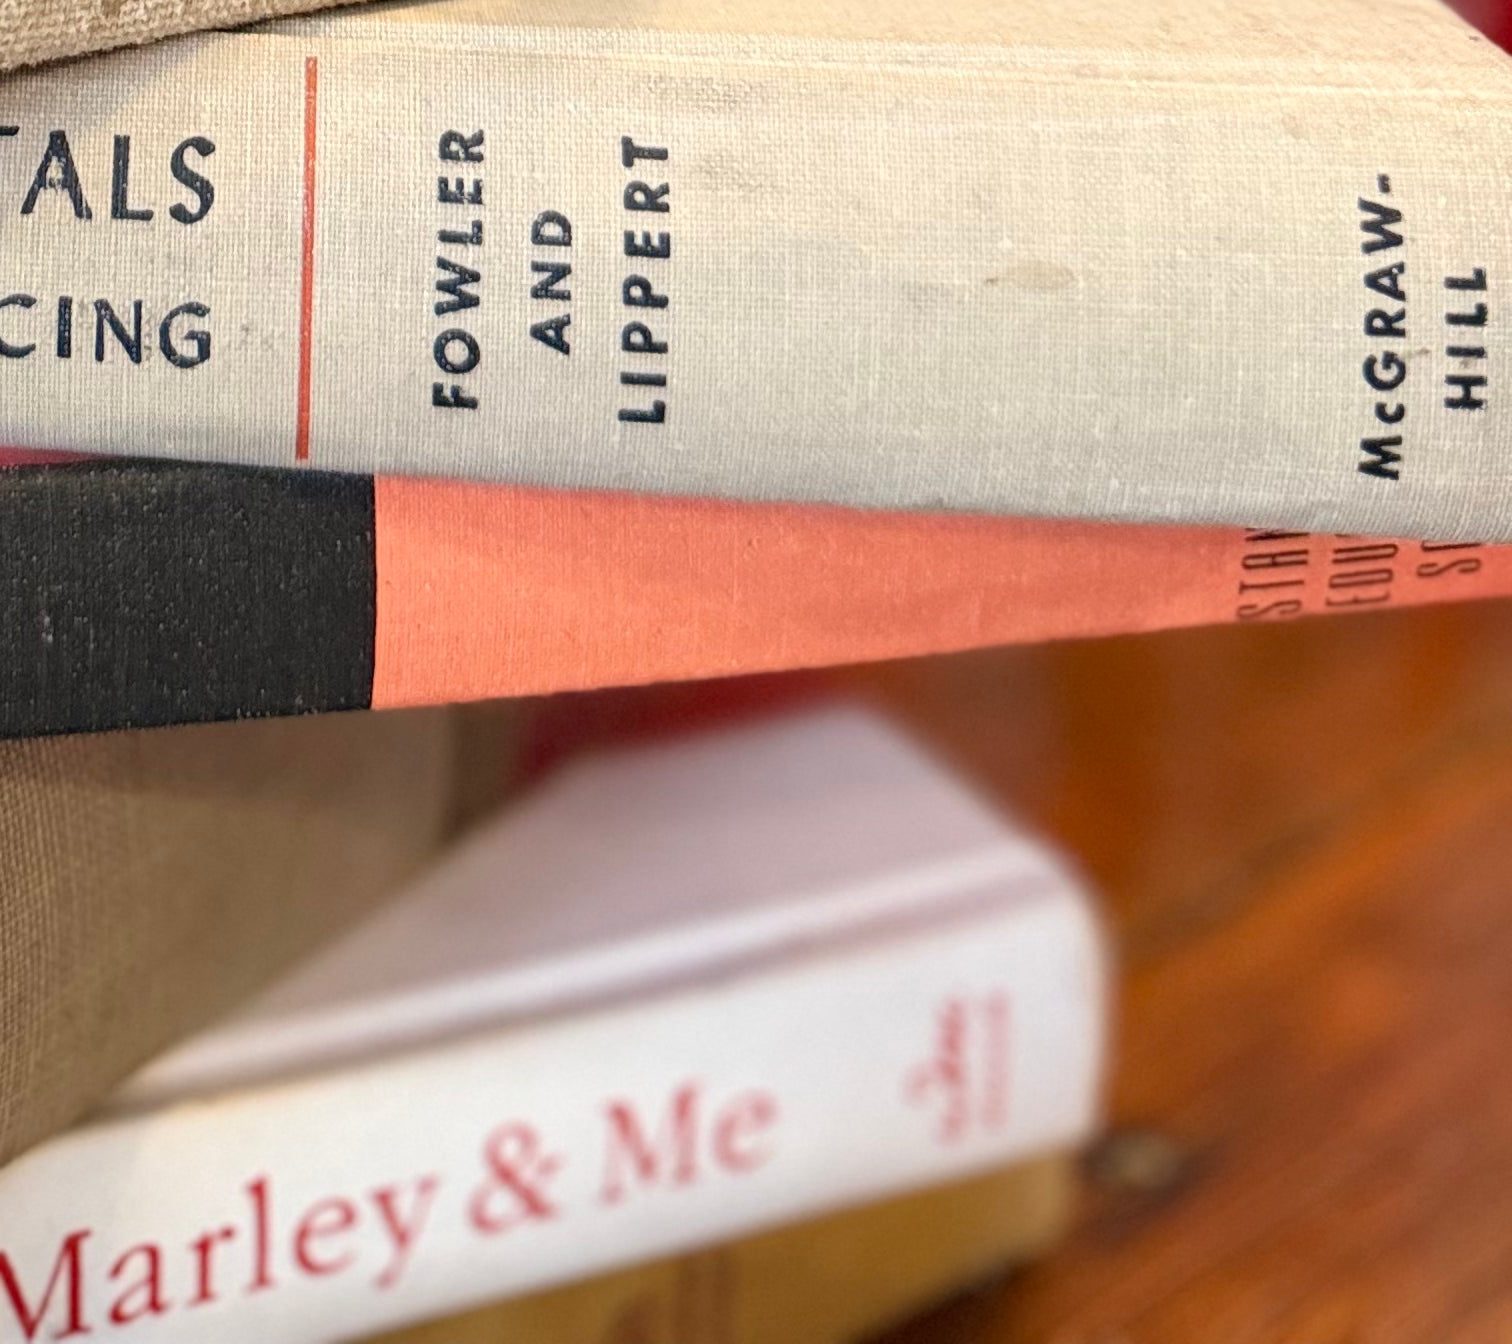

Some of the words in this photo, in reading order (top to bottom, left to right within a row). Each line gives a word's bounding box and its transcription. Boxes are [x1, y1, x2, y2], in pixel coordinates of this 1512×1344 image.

[431, 127, 485, 410] FOWLER
[529, 209, 573, 356] AND
[617, 134, 671, 424] LIPPERT
[1356, 172, 1408, 481] McGRAW-
[1443, 266, 1489, 411] HILL
[466, 1120, 563, 1239] &
[594, 1076, 779, 1208] Me
